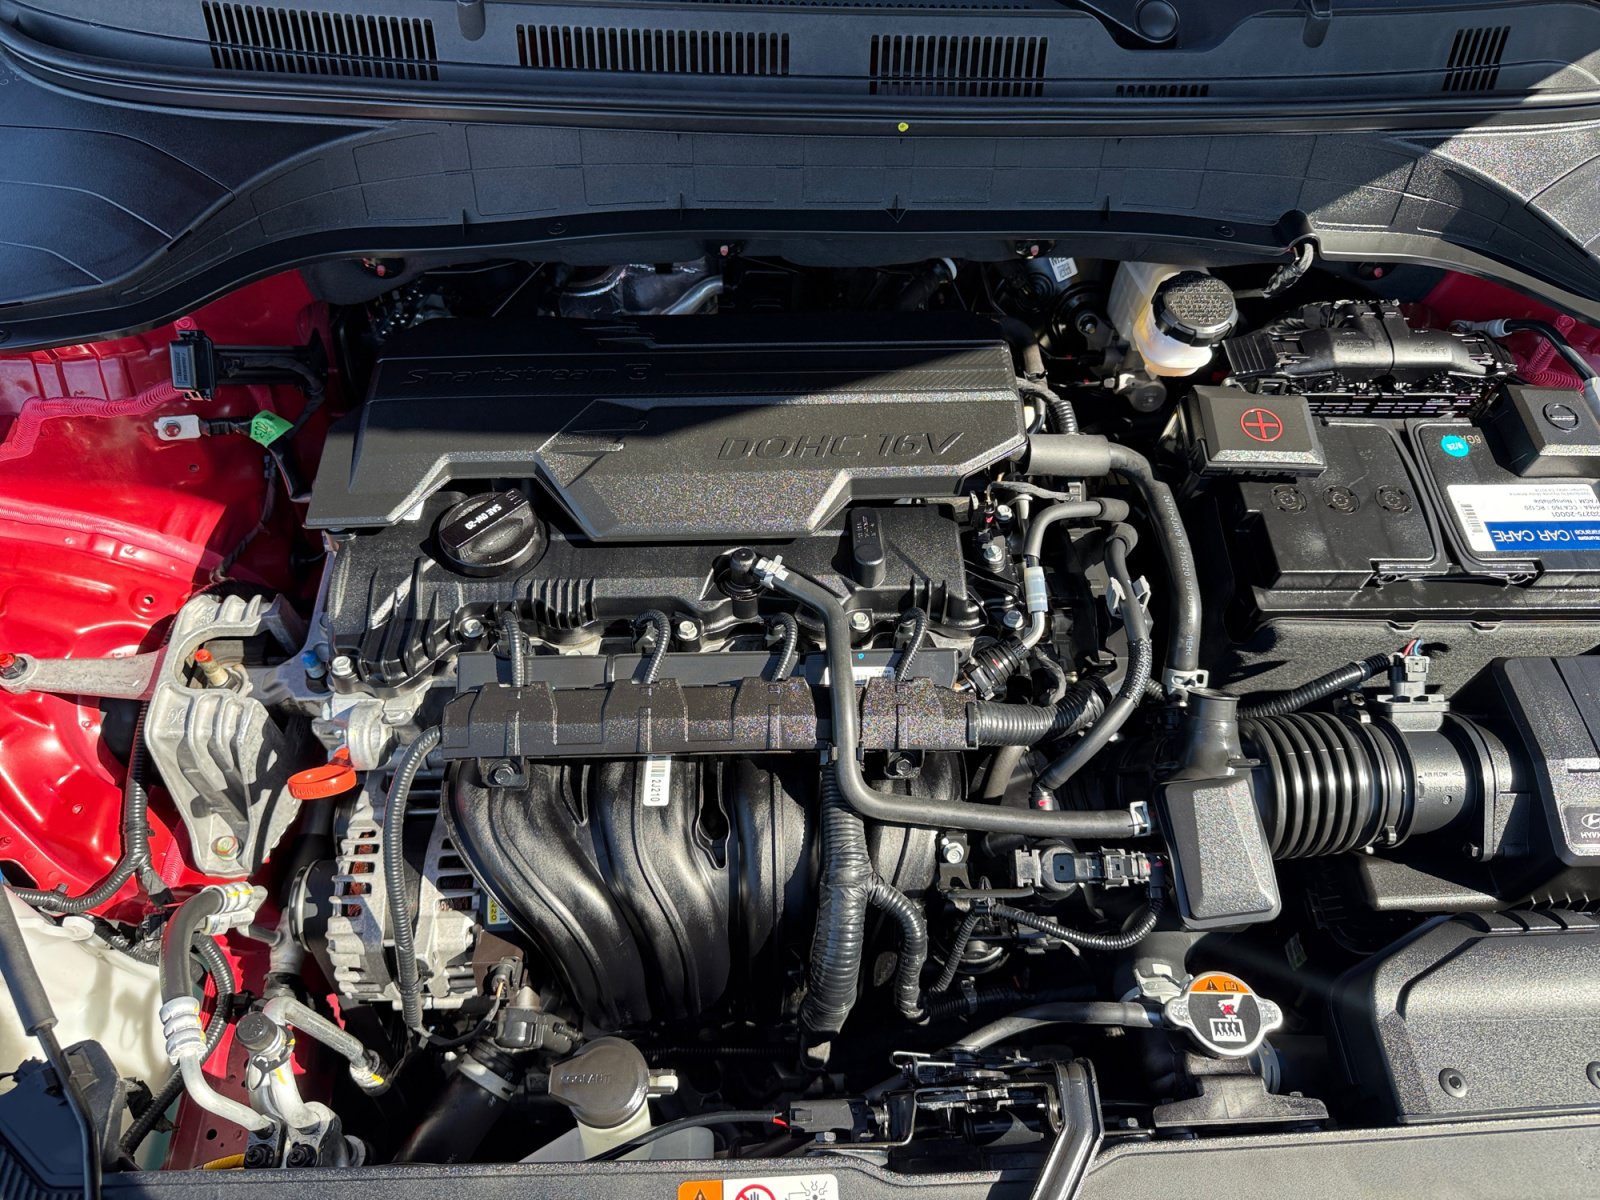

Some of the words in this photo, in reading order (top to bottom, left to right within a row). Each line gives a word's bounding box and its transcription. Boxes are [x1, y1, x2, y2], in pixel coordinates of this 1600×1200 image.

[717, 434, 868, 461] DOHC
[878, 431, 965, 457] 16V
[485, 503, 503, 517] SAE
[1491, 529, 1535, 542] CARE
[1536, 529, 1571, 542] CAR
